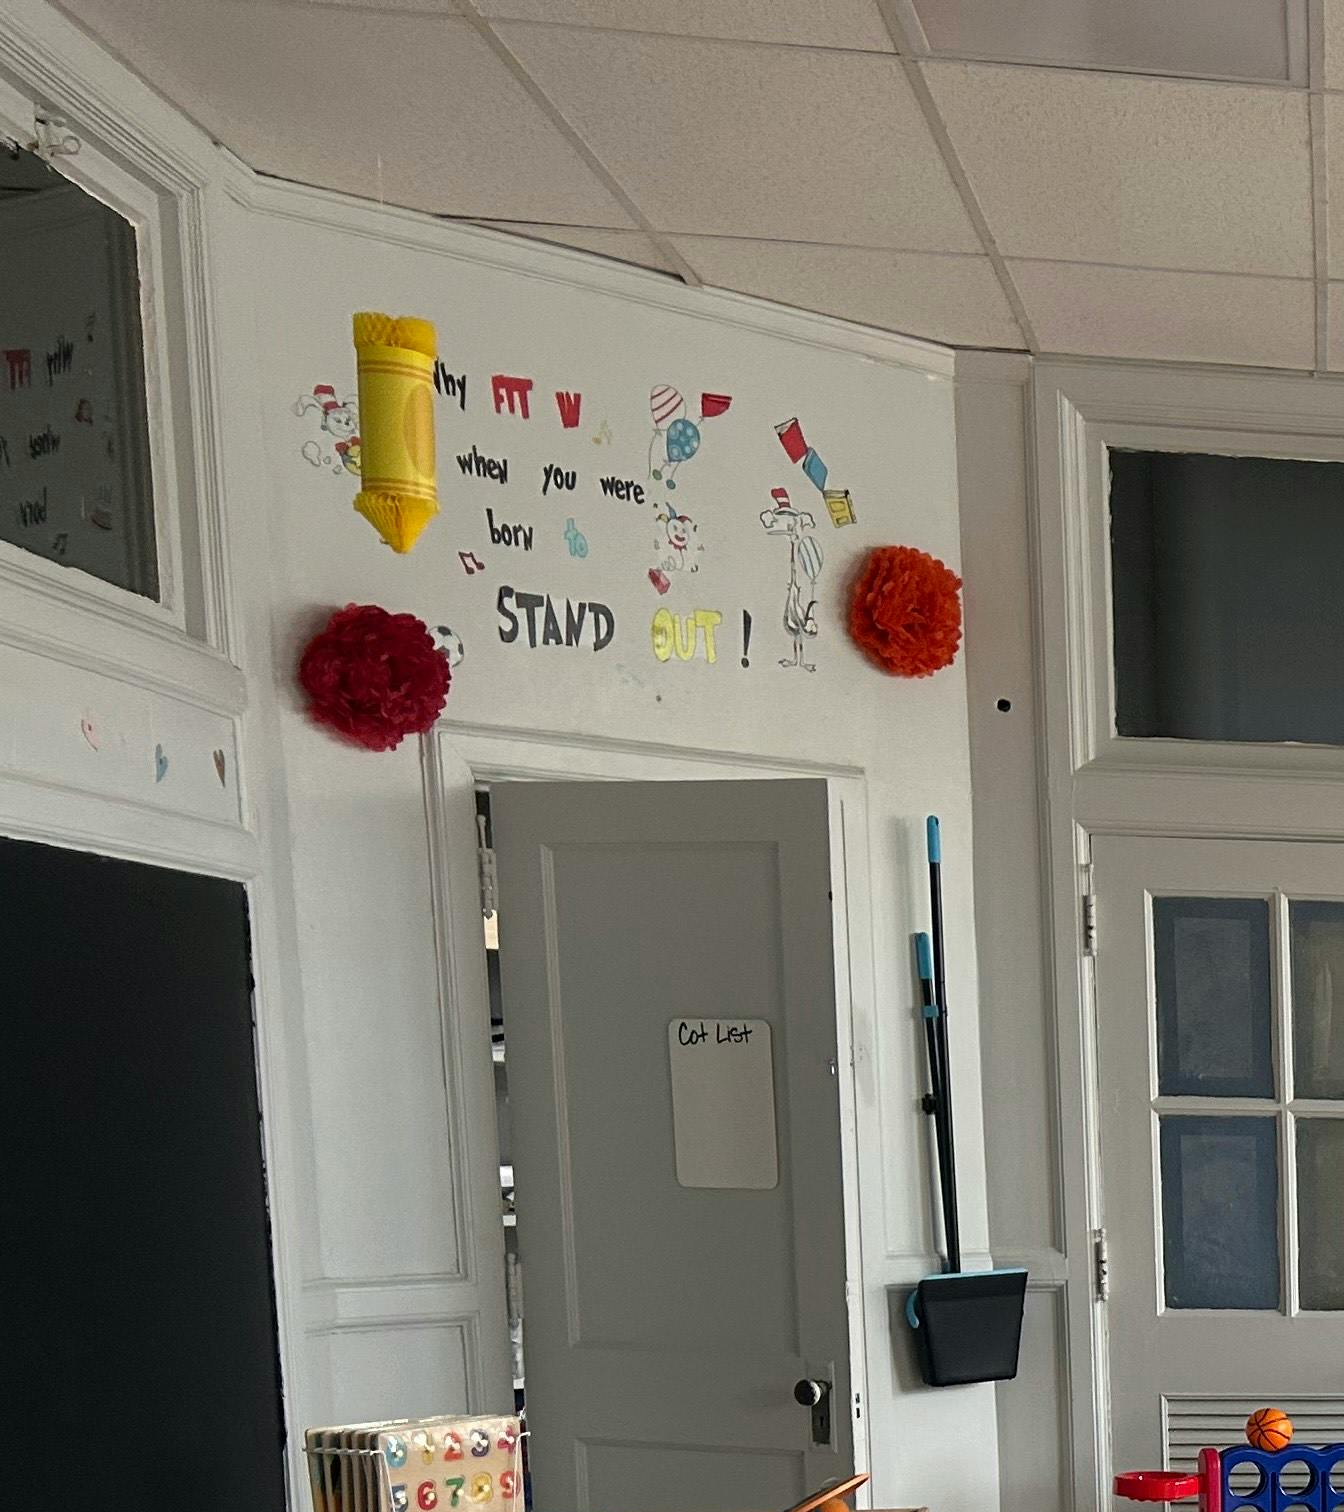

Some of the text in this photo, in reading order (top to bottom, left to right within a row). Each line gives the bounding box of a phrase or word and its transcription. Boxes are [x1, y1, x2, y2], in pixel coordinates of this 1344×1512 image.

[541, 464, 577, 496] you
[600, 477, 645, 504] were
[486, 508, 534, 551] born
[496, 585, 615, 652] STAND
[678, 1021, 709, 1046] Cot
[417, 1480, 439, 1511] 6
[444, 1474, 466, 1507] 7
[500, 1470, 521, 1499] 9
